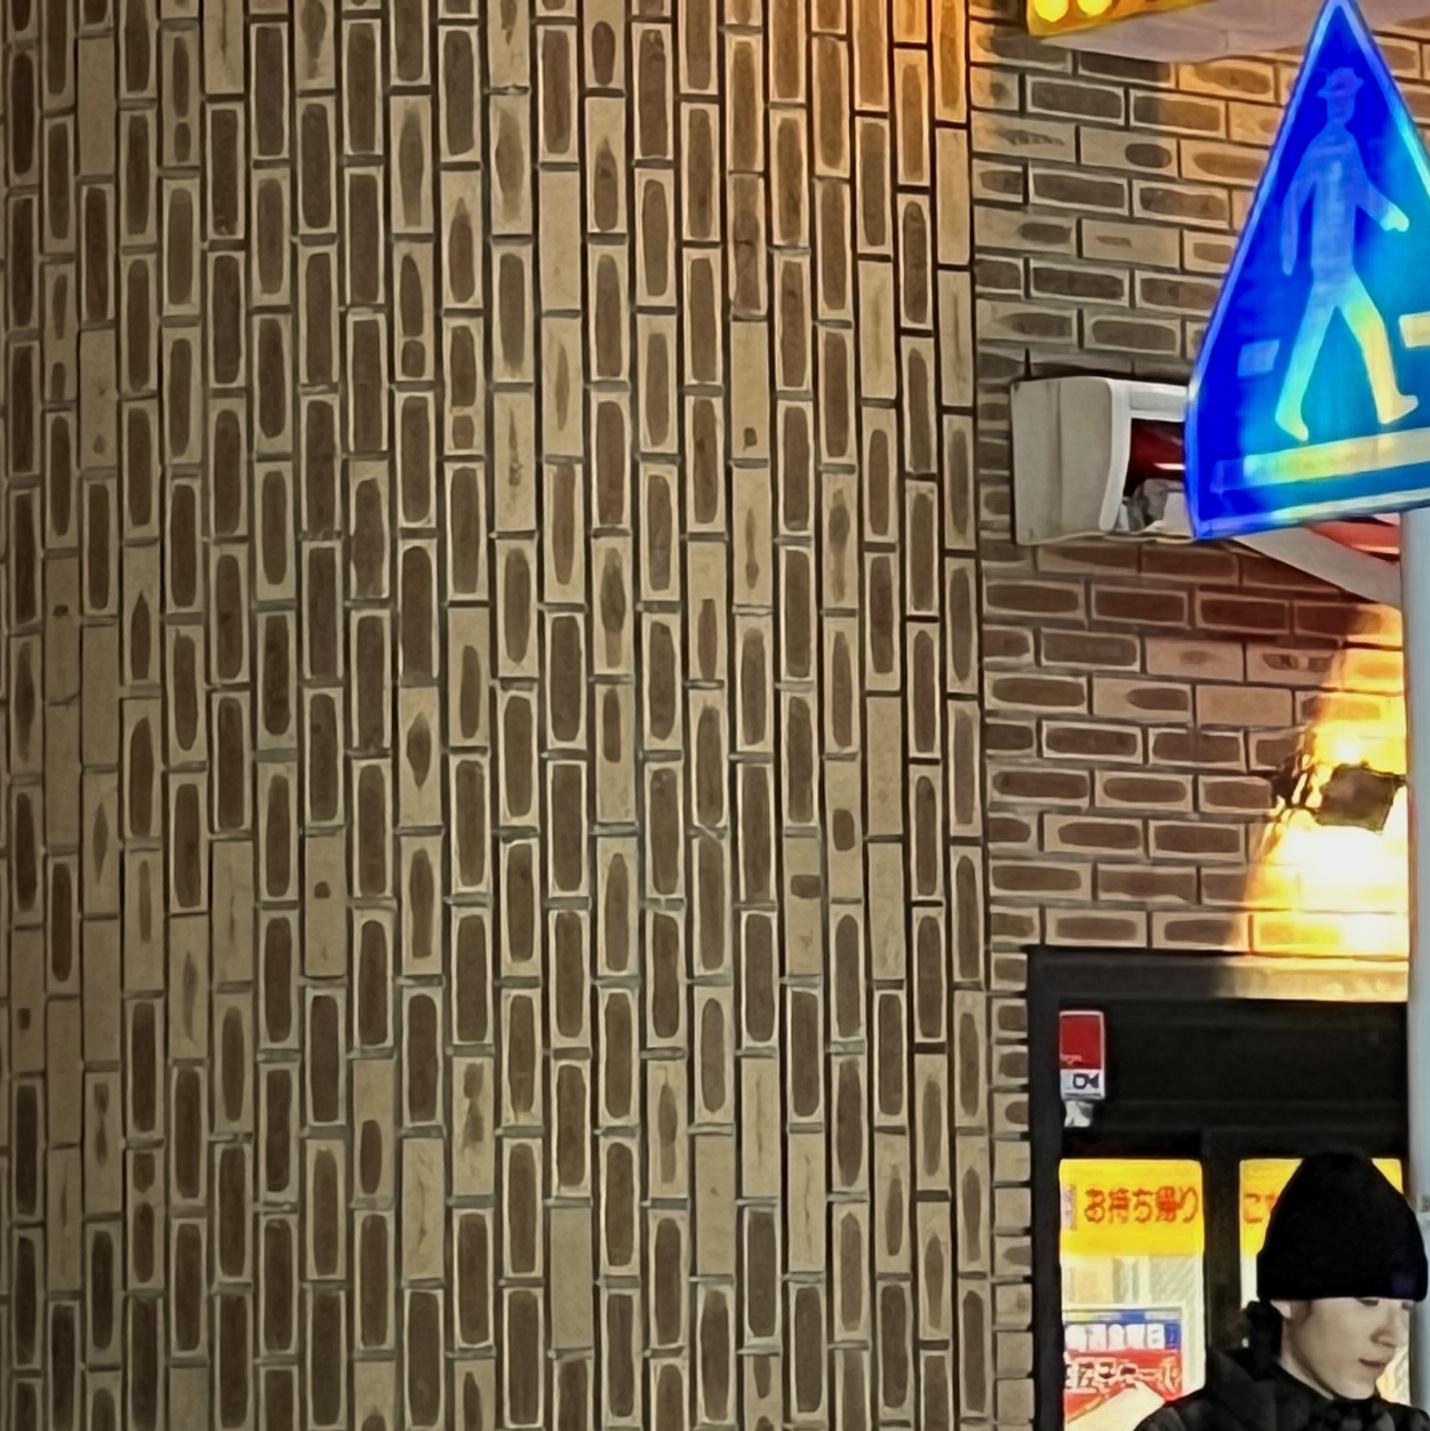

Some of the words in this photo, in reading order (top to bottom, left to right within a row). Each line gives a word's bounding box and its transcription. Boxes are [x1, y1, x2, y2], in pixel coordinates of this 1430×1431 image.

[1084, 1186, 1199, 1225] お持ち帰り
